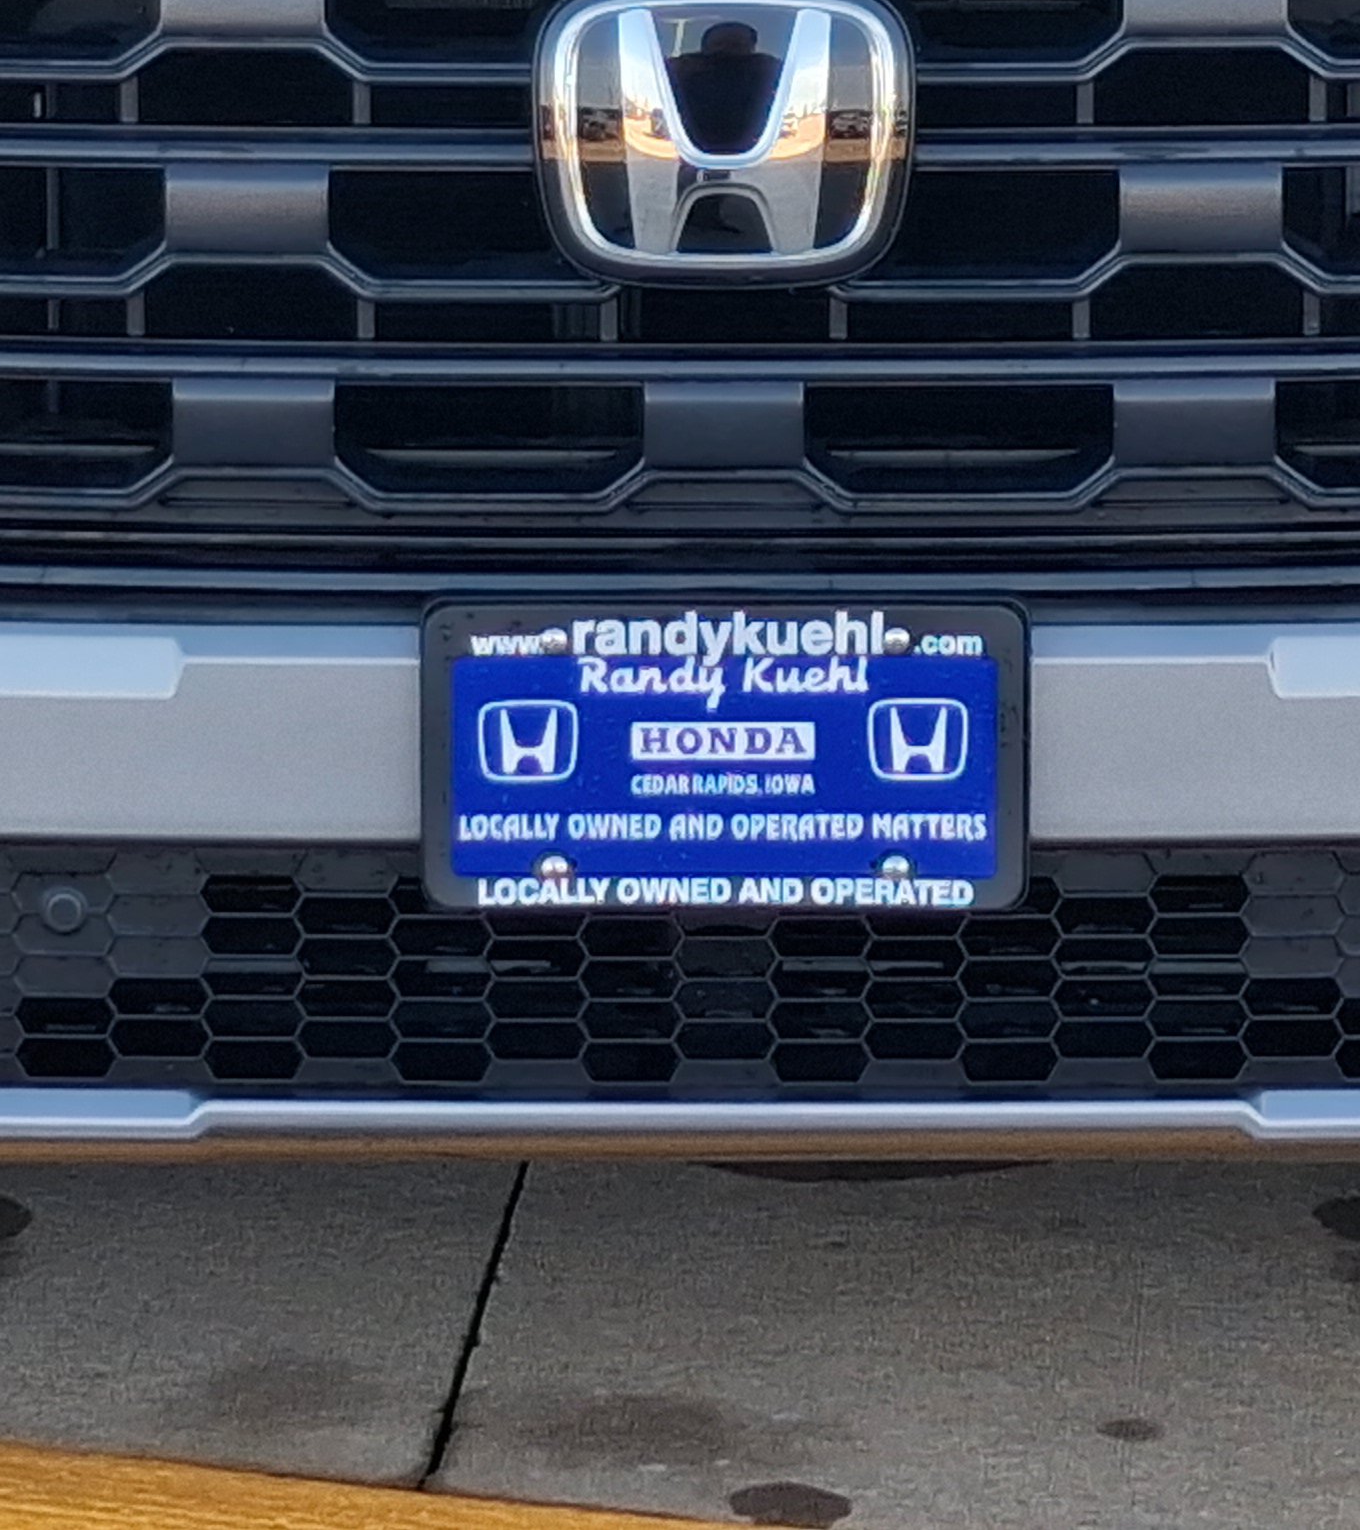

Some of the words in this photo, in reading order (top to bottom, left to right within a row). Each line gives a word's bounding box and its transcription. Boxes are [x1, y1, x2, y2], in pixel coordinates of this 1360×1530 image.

[573, 610, 885, 667] randykuehl
[578, 656, 726, 711] Randy
[742, 656, 869, 694] Kuehl
[641, 727, 807, 755] HONDA
[631, 774, 689, 795] CEDAR
[765, 774, 816, 795] IOWA
[458, 813, 560, 841] LOCALLY
[568, 813, 662, 841] OWNED
[669, 813, 724, 841] AND
[731, 813, 864, 841] OPERATED
[872, 813, 987, 841] MATTERS
[477, 877, 609, 905] LOCALLY
[617, 877, 732, 905] OWNED
[738, 877, 804, 905] AND
[811, 877, 975, 906] OPERATED
